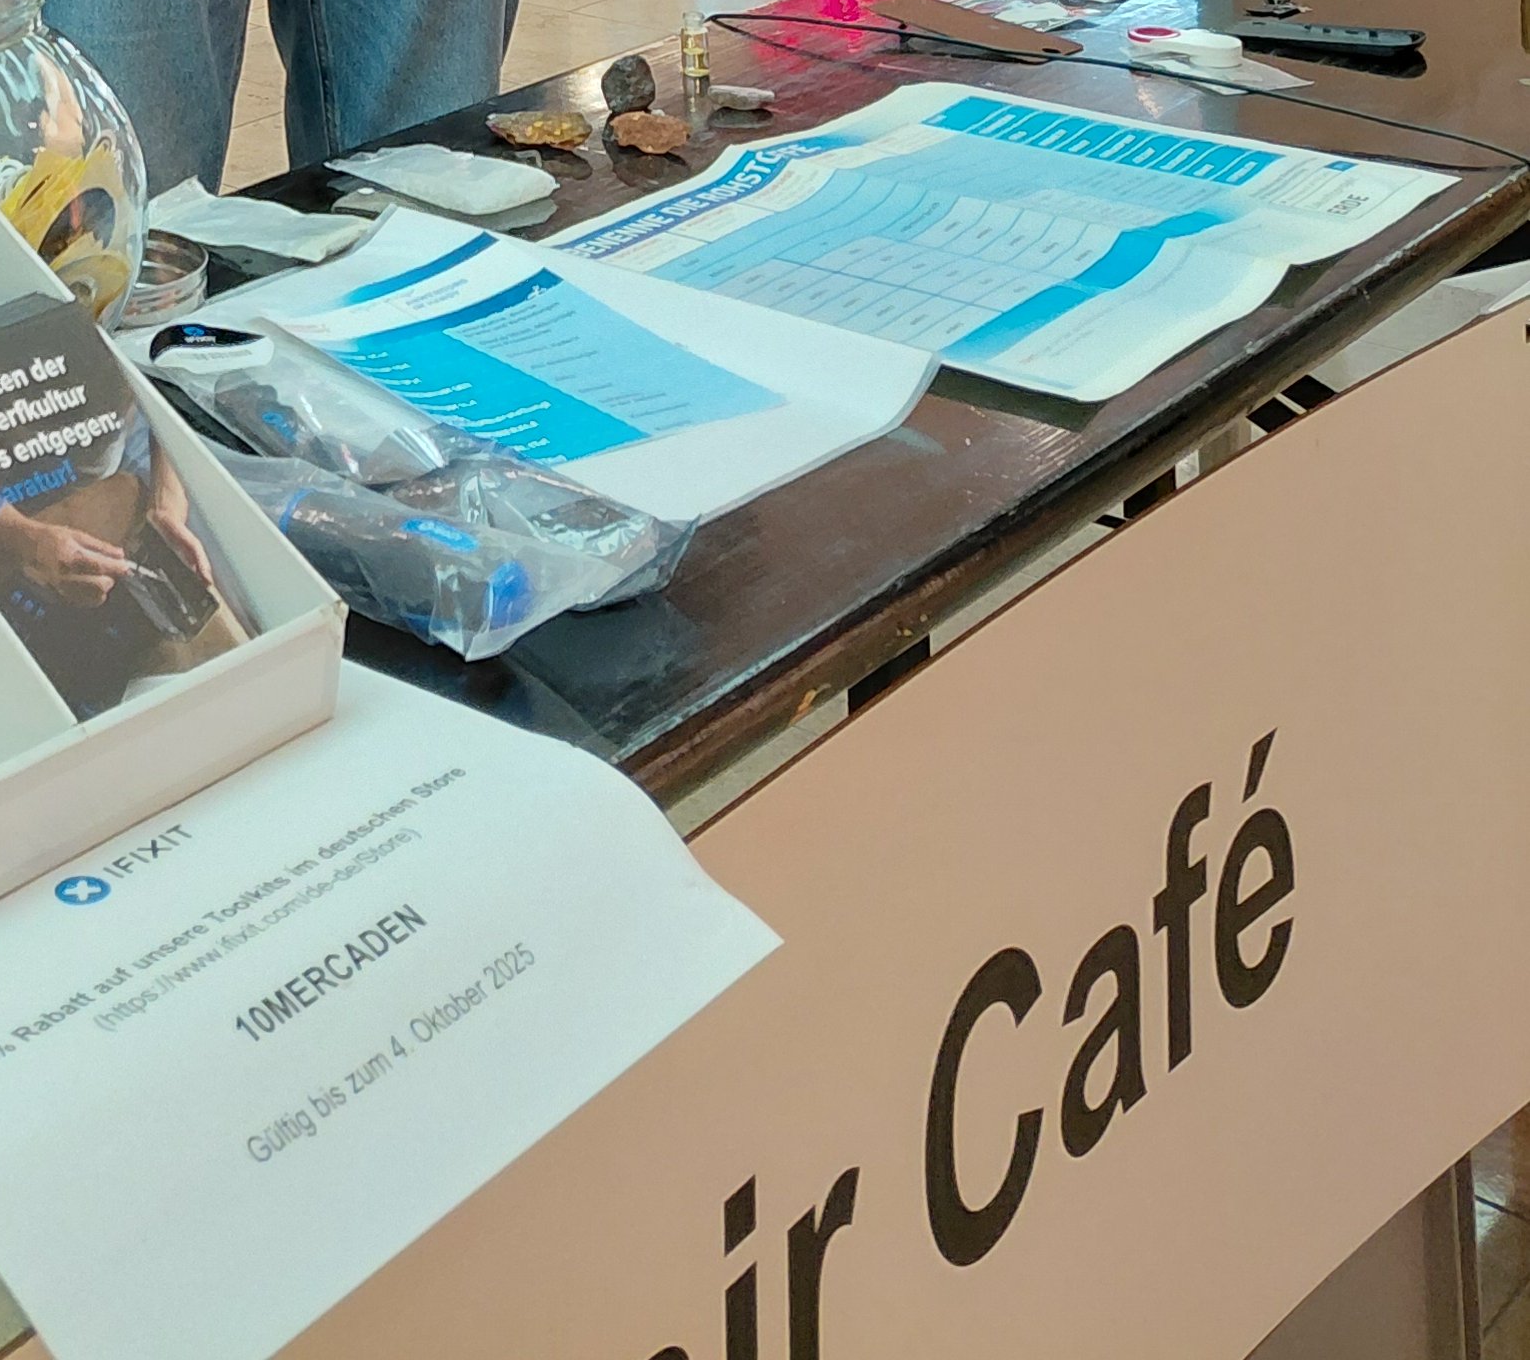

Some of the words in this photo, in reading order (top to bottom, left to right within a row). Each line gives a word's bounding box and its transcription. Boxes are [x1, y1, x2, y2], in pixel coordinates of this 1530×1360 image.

[666, 192, 711, 224] DIE
[29, 354, 67, 382] der
[13, 411, 122, 462] entgegen:
[103, 824, 192, 878] IFIXIT
[11, 991, 96, 1042] Rabatt
[93, 967, 133, 995] auf
[132, 923, 209, 970] unsere
[201, 874, 291, 923] Toolkits
[289, 858, 319, 877] im
[318, 796, 419, 860] deutschen
[410, 766, 467, 799] Store
[236, 903, 427, 1043] 10MERCADEN
[925, 727, 1295, 1267] Café
[246, 1108, 318, 1164] Gültig
[308, 1084, 348, 1119] bis
[344, 1051, 392, 1094] zum
[390, 1035, 416, 1059] 4.
[409, 980, 489, 1043] Oktober
[482, 942, 536, 991] 2025
